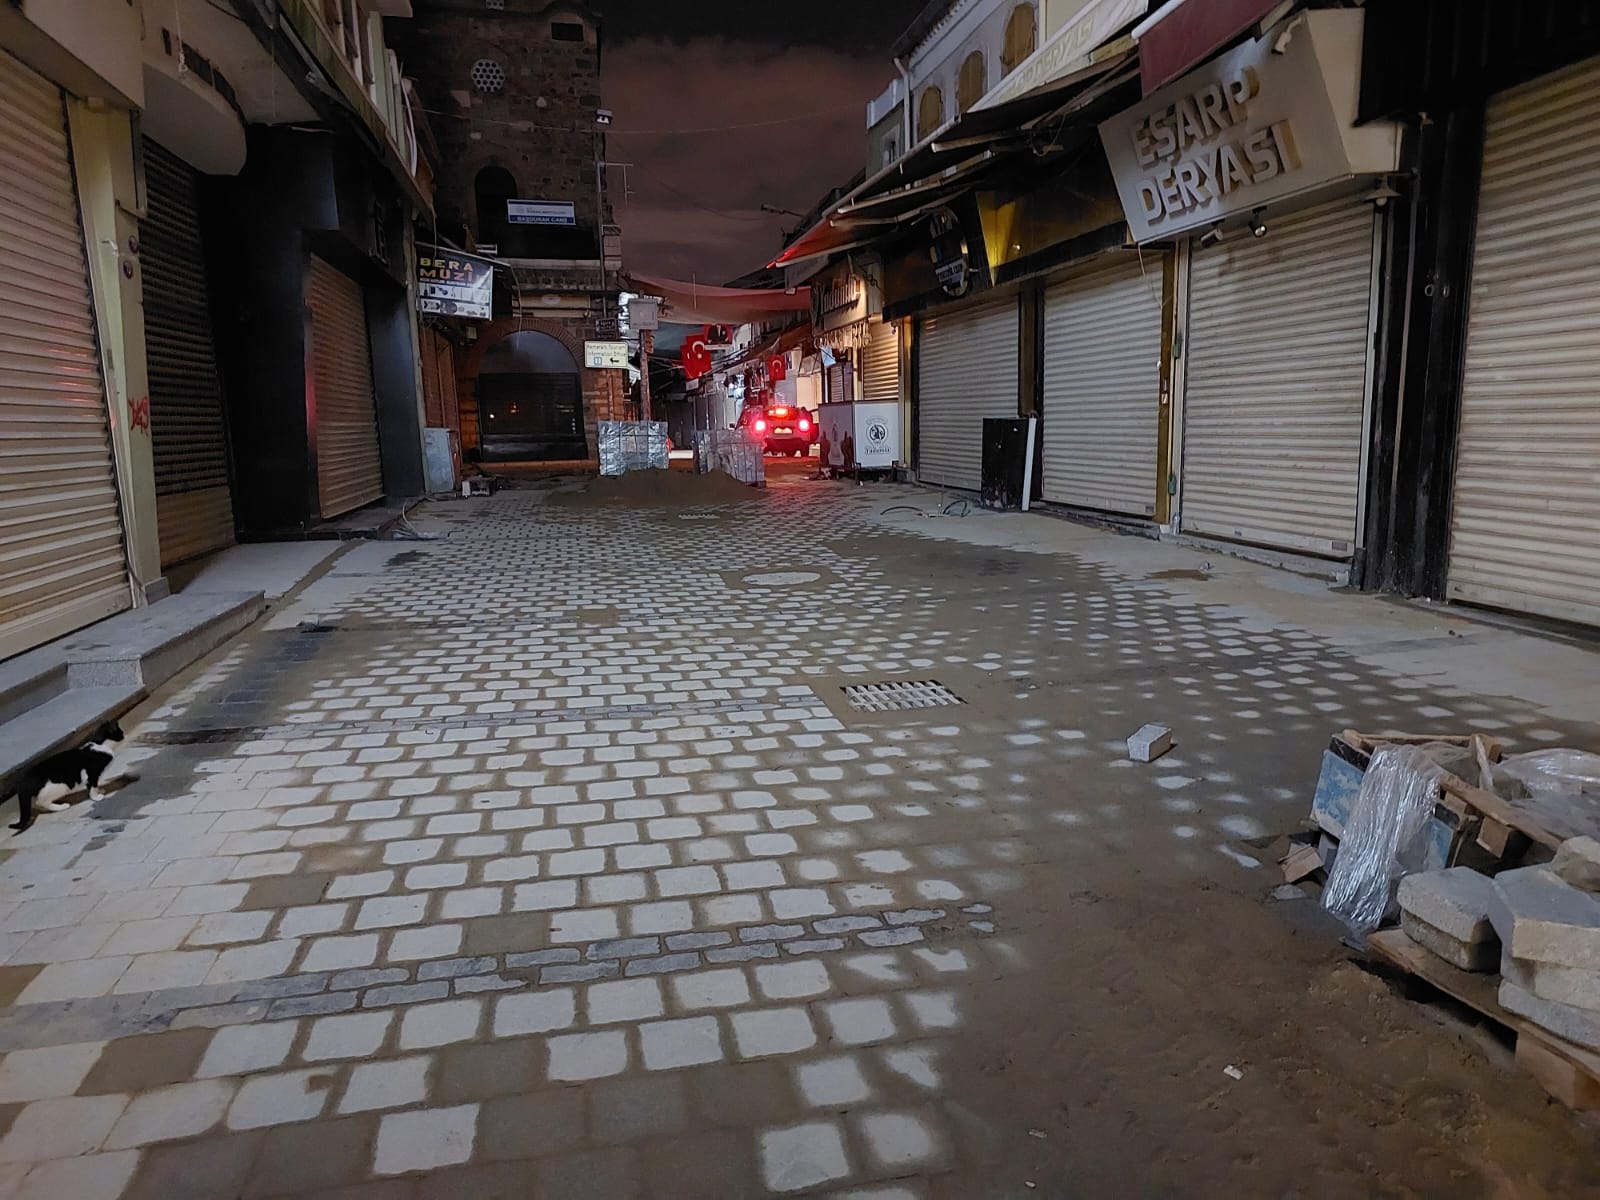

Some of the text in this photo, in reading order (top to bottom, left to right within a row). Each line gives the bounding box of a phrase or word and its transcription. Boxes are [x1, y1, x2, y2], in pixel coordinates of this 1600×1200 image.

[1131, 66, 1258, 168] EŞARP
[1135, 120, 1300, 222] DERYASI
[420, 258, 473, 272] BERA
